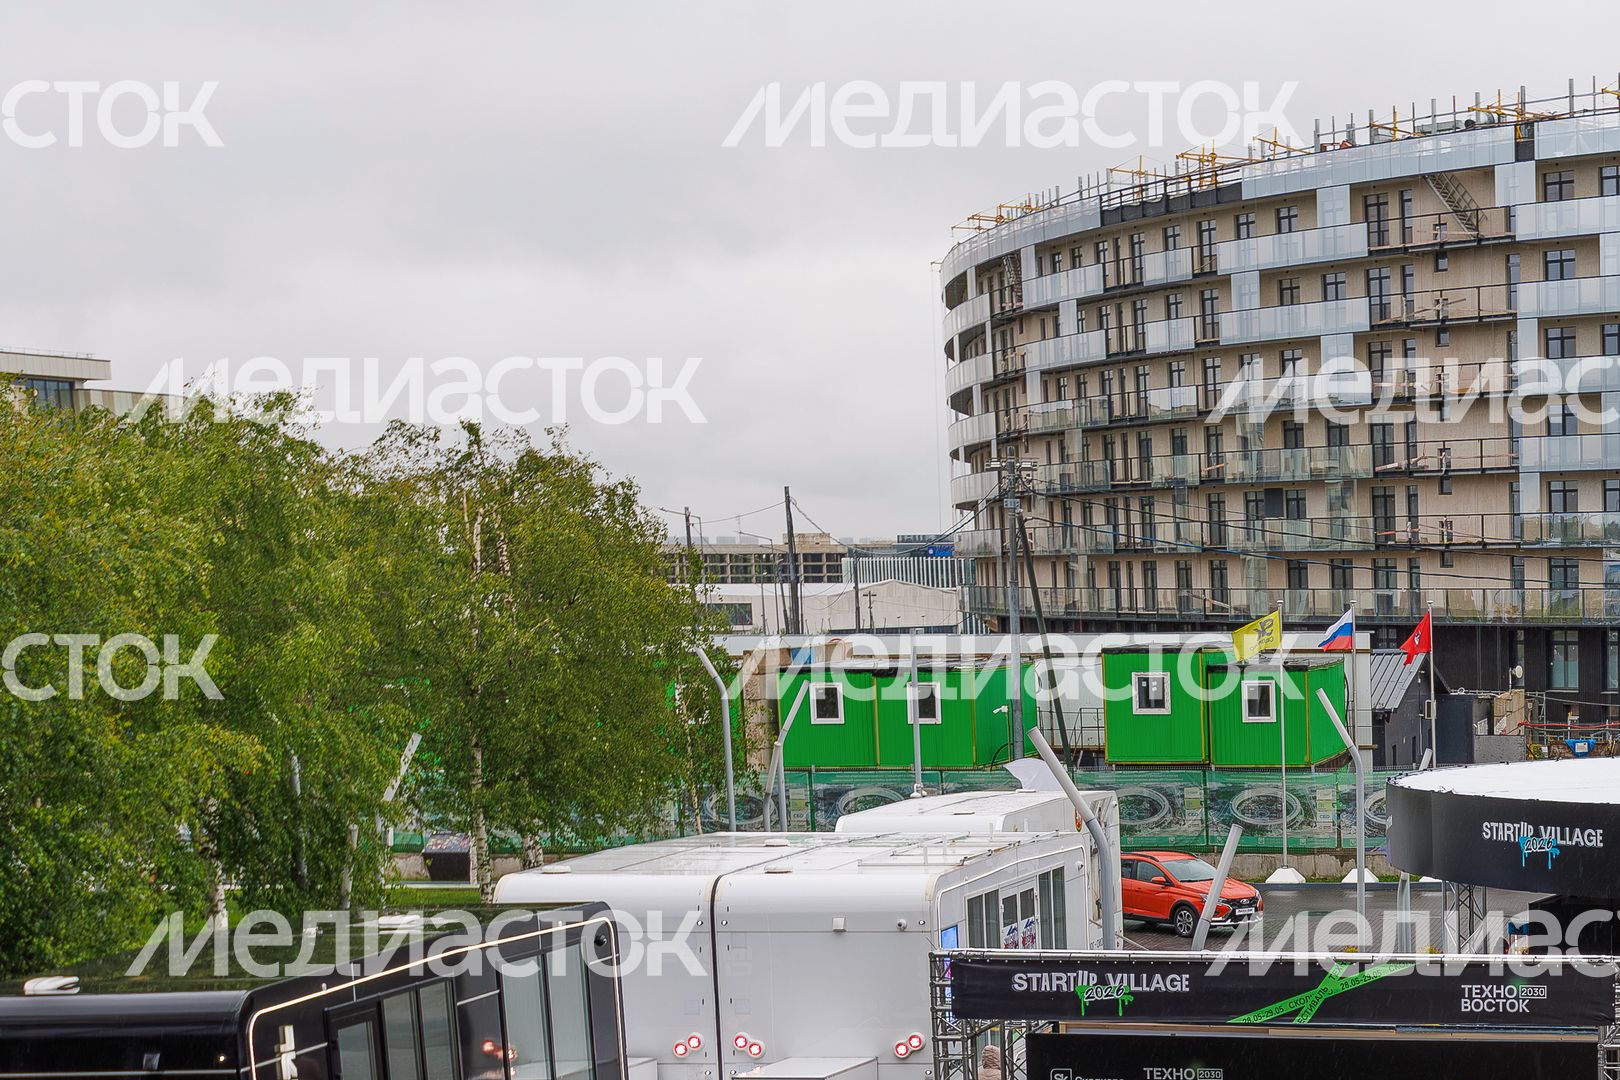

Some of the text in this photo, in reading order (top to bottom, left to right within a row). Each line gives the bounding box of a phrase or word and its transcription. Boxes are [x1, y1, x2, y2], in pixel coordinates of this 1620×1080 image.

[1482, 821, 1604, 847] STARTUP VILLAGE
[1524, 837, 1554, 852] 2026
[1012, 970, 1190, 992] STARTUP VILLAGE
[1084, 985, 1125, 1001] 2026
[1461, 984, 1545, 998] ТЕХНО 2030
[1461, 999, 1530, 1013] ВОСТОК
[1144, 1067, 1221, 1080] ТЕХНО 2030
